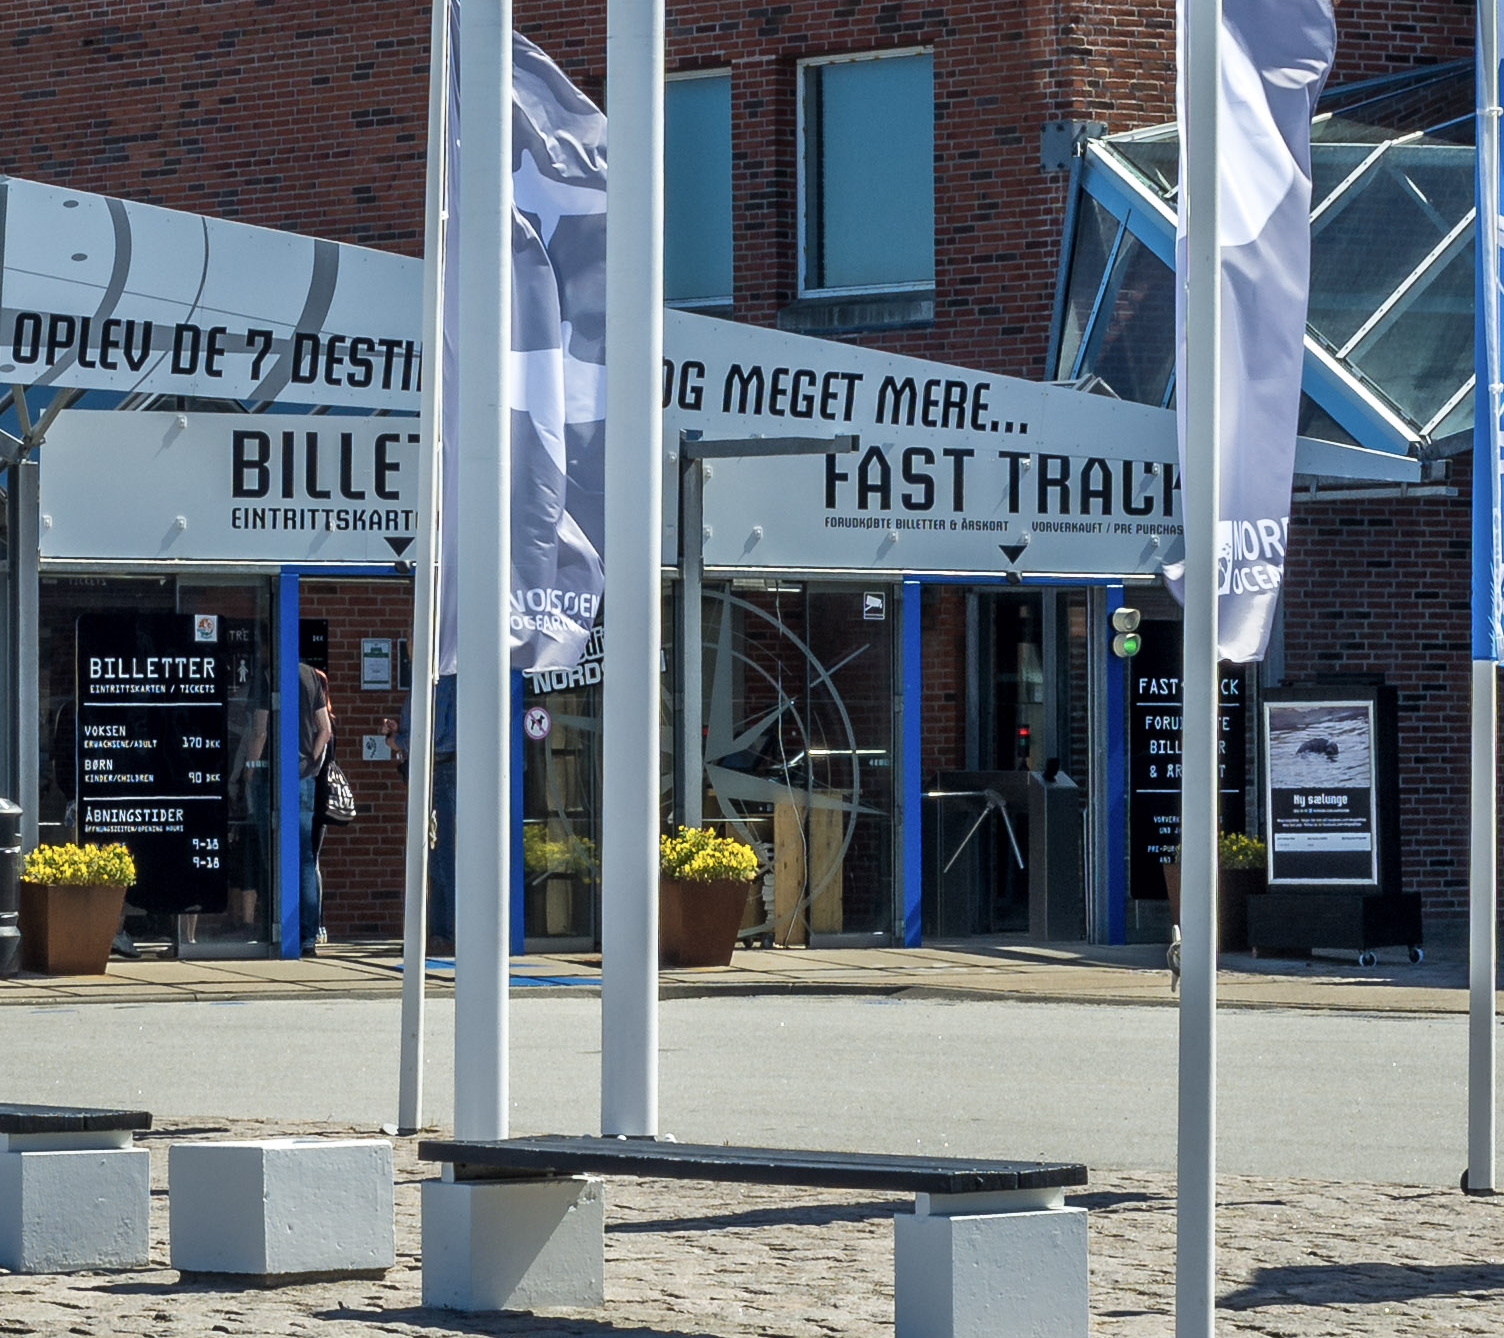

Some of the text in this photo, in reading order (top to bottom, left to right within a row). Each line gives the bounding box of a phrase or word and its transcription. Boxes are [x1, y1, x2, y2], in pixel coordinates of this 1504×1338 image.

[12, 312, 153, 372] OPLEV
[171, 323, 227, 379] DE
[245, 328, 273, 381] 7
[291, 332, 422, 392] DESTI
[722, 363, 863, 423] MEGET
[875, 374, 1029, 435] MERE...
[231, 507, 420, 532] EINTRITTSKART
[824, 515, 892, 530] FORUDKØBTE
[895, 517, 946, 532] BILLETTER
[949, 519, 959, 531] &
[960, 516, 1009, 532] ÅRSKORT
[1114, 523, 1133, 535] PRE
[1136, 523, 1184, 536] PURCHAS
[89, 657, 215, 679] BILLETTER
[533, 662, 605, 694] NORD
[89, 684, 166, 694] EINTRITTSKARTEN
[180, 684, 215, 694] TICKETS
[84, 725, 126, 737] VOKSEN
[83, 736, 221, 749] ERWACHSENE/ADULT 170 DKK
[84, 759, 113, 771] BØRN
[84, 771, 221, 784] KINDER/CHILDREN 90 DKK
[1293, 792, 1349, 808] Ny sælunge
[84, 805, 185, 822] ÅBNINGSTIDER
[191, 837, 220, 850] 9-18
[191, 856, 220, 869] 9-18
